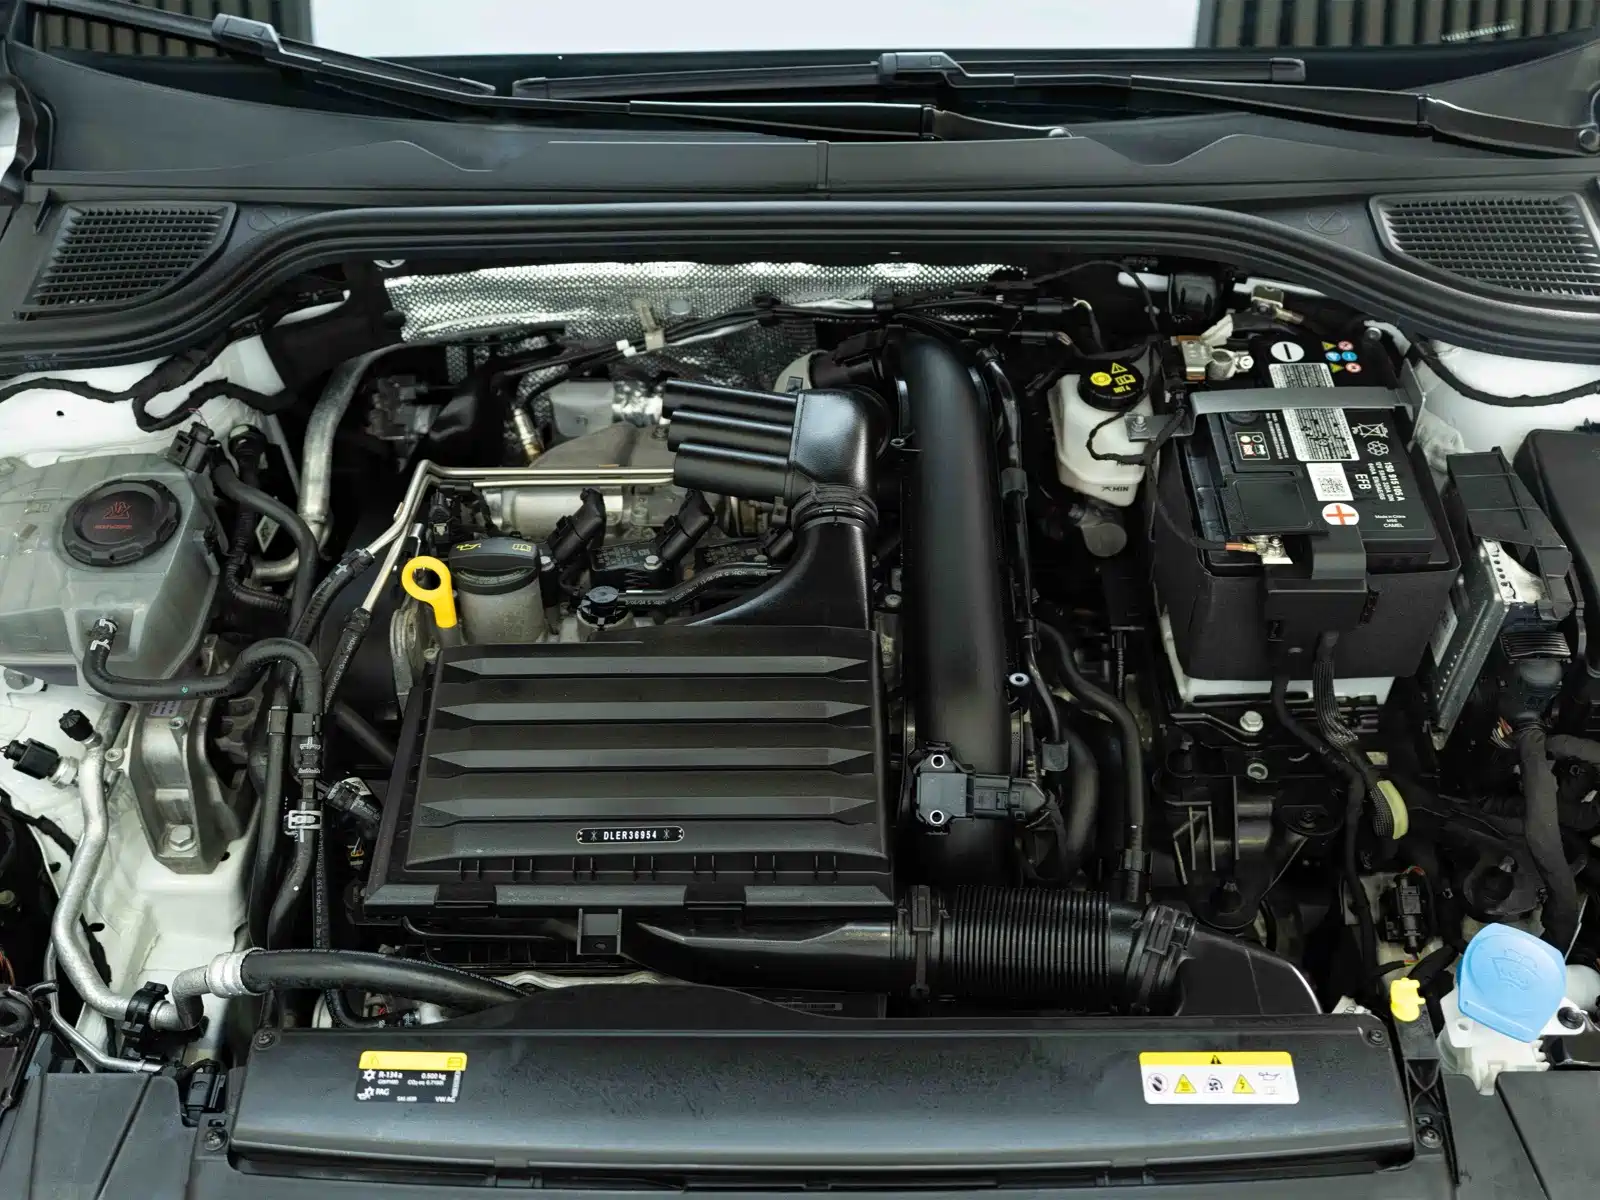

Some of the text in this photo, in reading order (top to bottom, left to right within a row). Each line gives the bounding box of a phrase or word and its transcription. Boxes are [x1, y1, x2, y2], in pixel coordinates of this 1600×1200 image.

[1354, 473, 1372, 490] EFB
[603, 830, 657, 841] DLER36954
[375, 1087, 390, 1096] PAG
